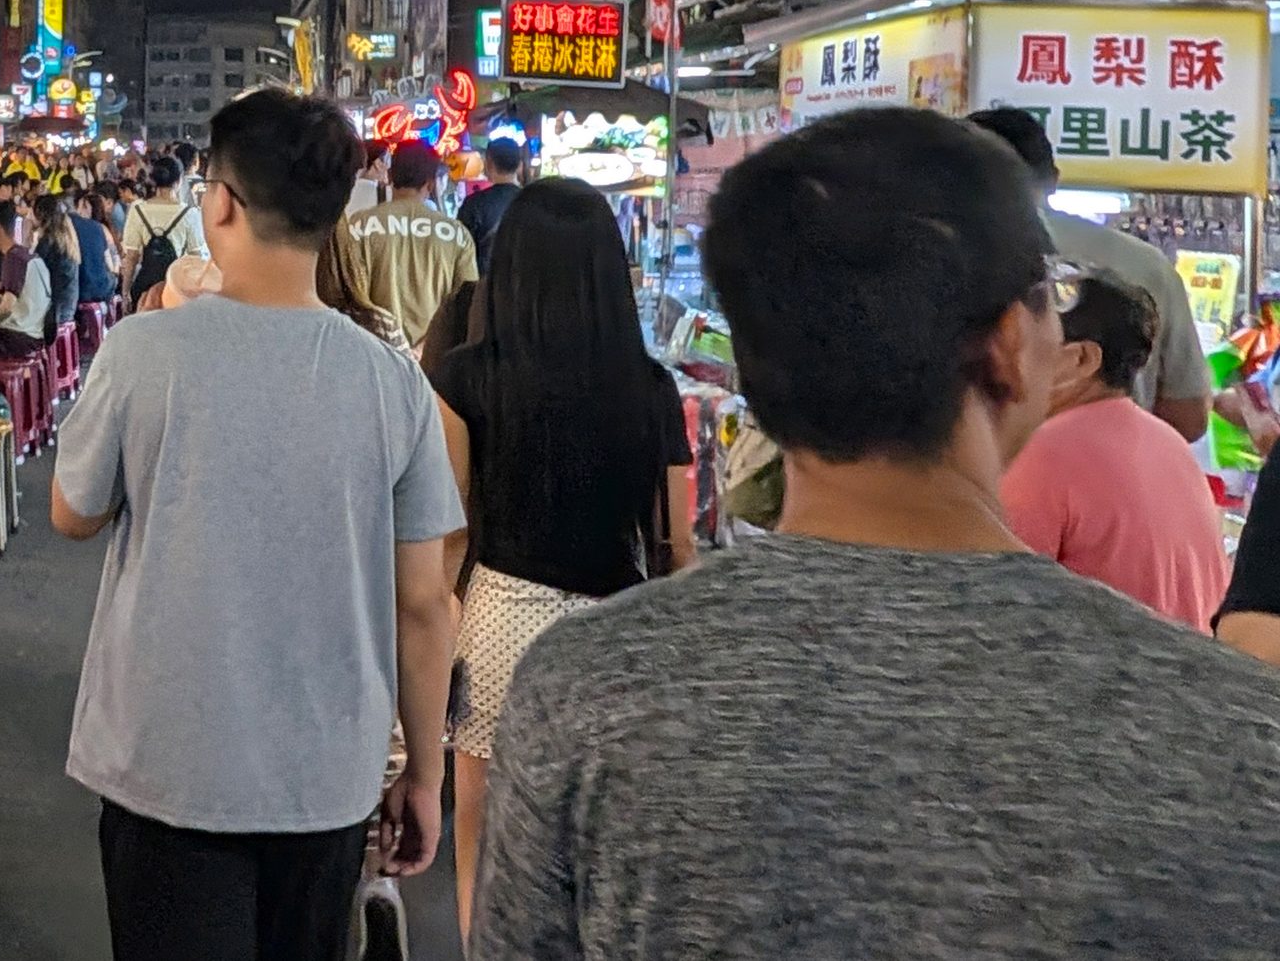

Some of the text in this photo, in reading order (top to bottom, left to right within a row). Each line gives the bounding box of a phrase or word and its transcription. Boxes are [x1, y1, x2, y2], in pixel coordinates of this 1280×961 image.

[821, 34, 881, 87] 鳳梨酥
[1017, 34, 1225, 90] 鳳梨酥
